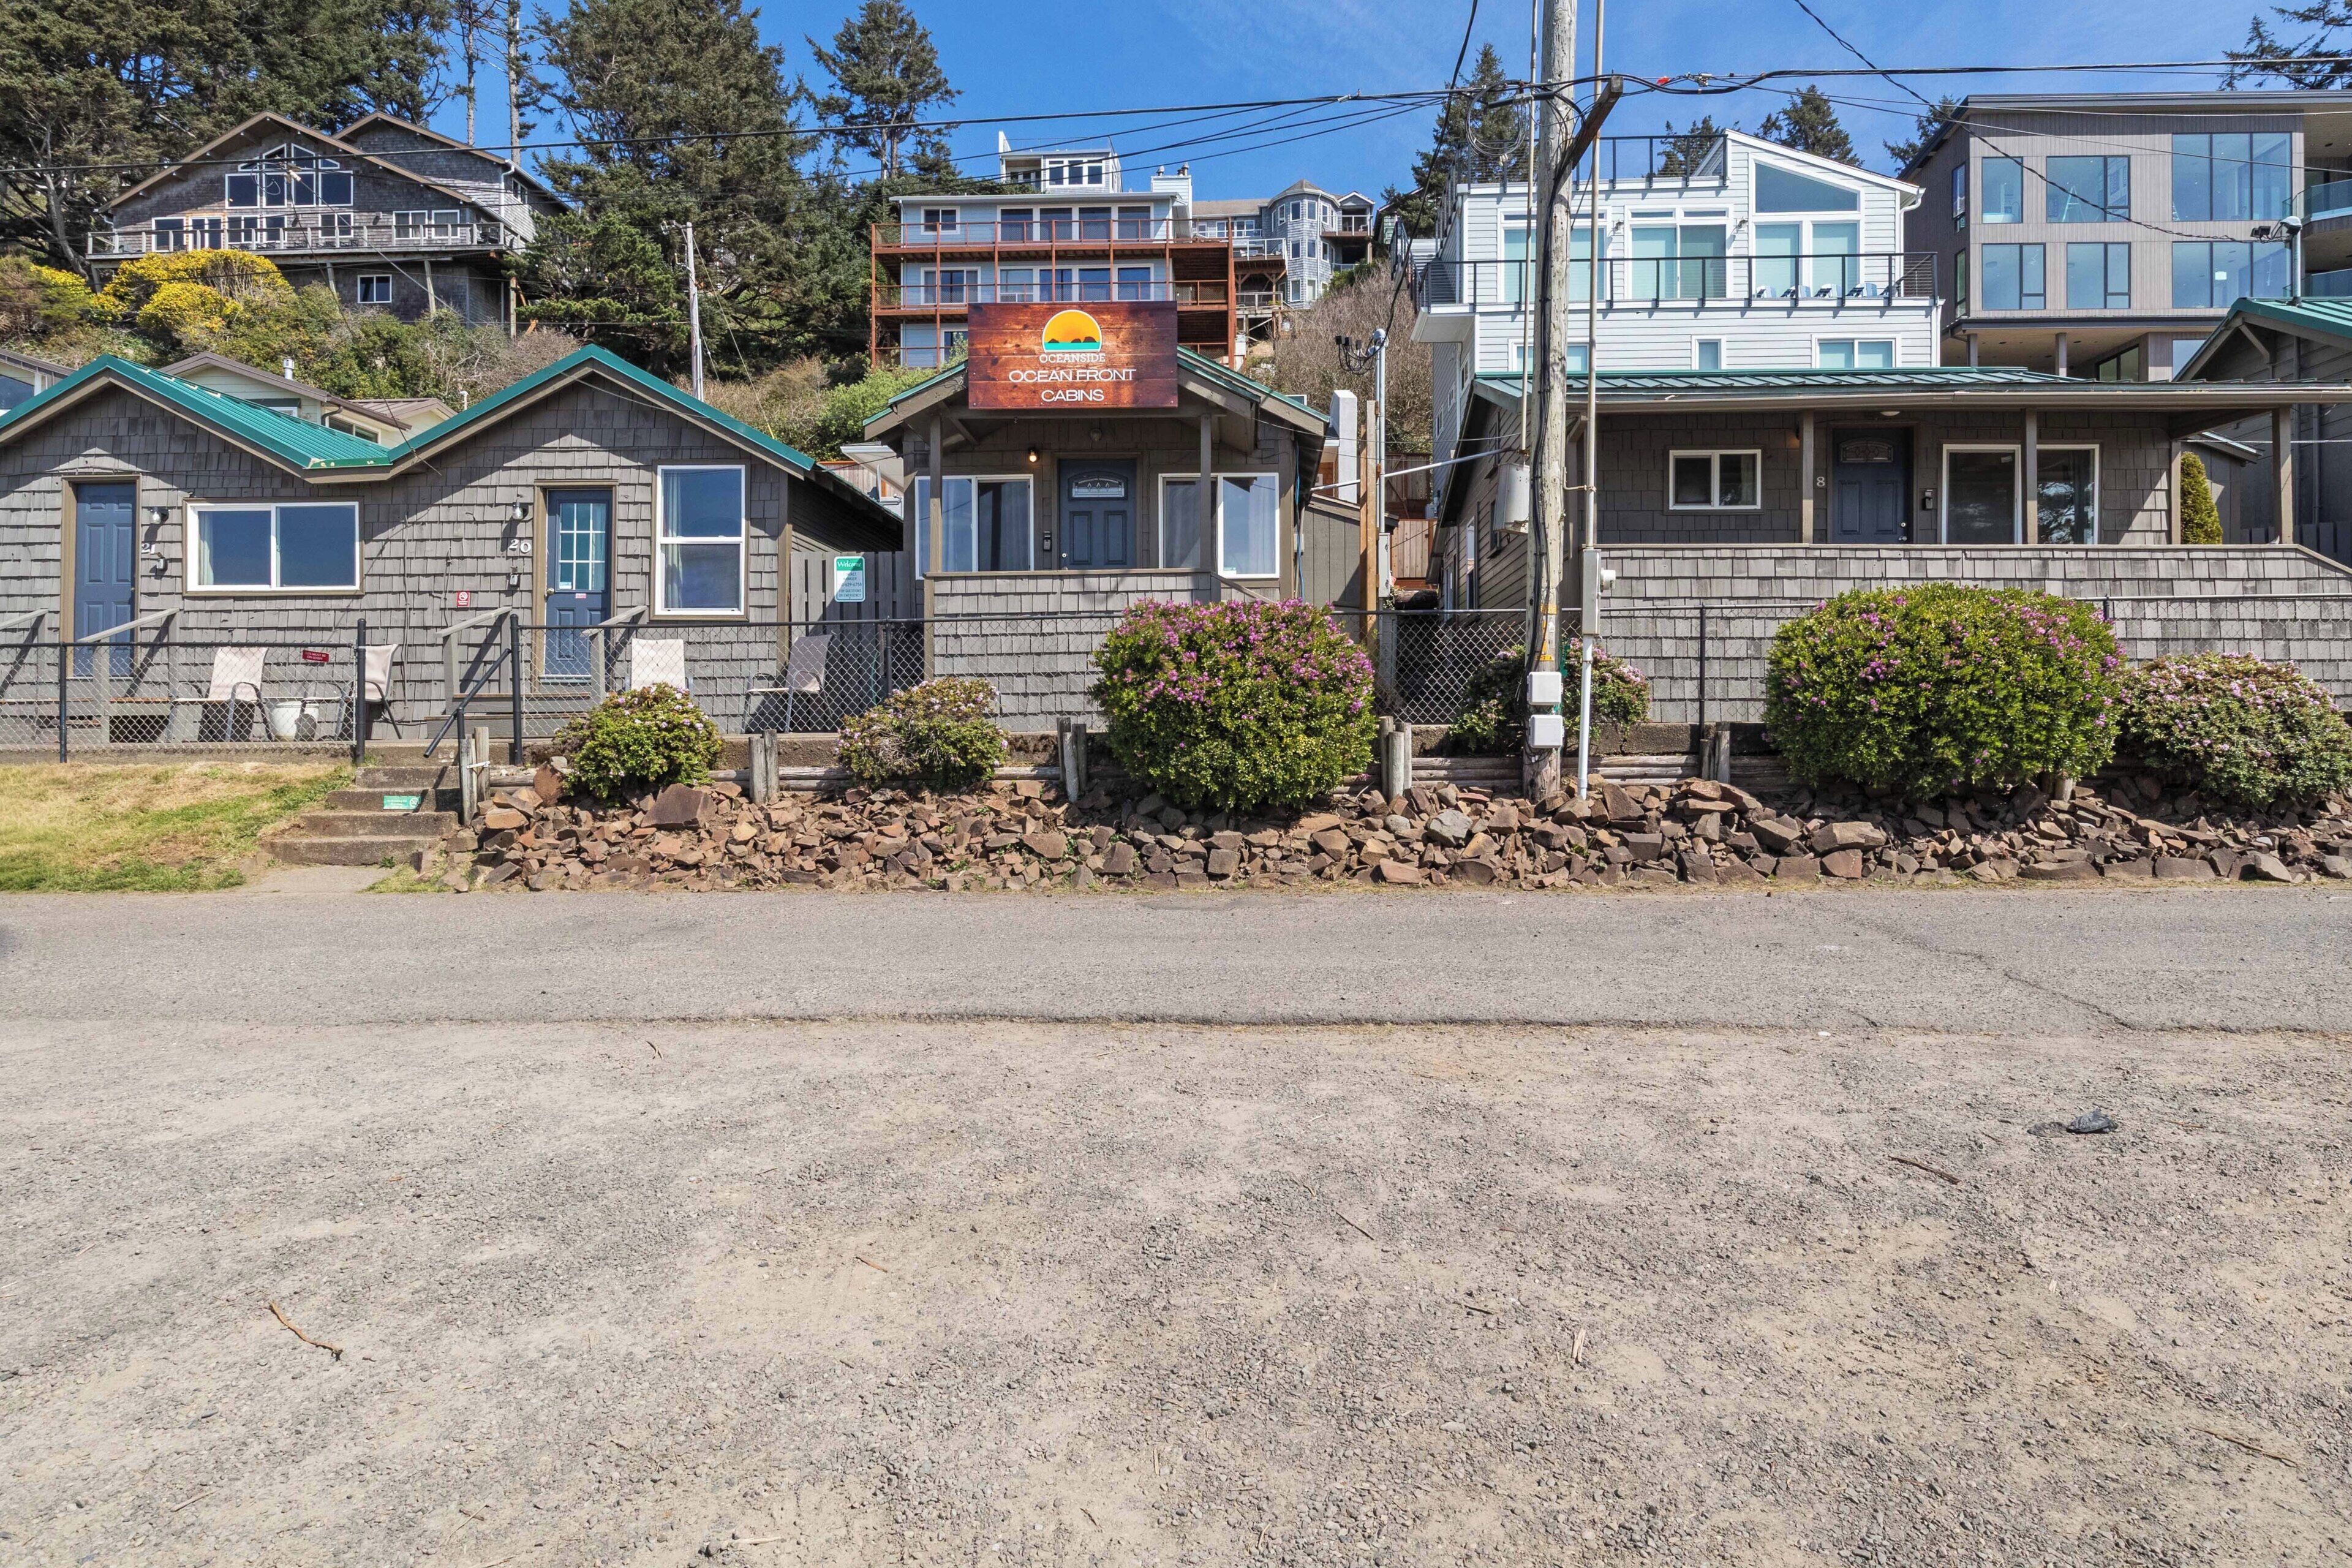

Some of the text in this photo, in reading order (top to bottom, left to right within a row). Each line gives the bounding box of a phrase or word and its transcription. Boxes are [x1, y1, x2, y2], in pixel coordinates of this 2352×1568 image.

[1039, 353, 1106, 363] OCEANSIDE
[1009, 369, 1137, 382] OCEAN FRONT
[1041, 389, 1104, 402] CABINS
[1817, 477, 1825, 487] 8
[141, 543, 156, 554] 21
[508, 539, 531, 552] 20
